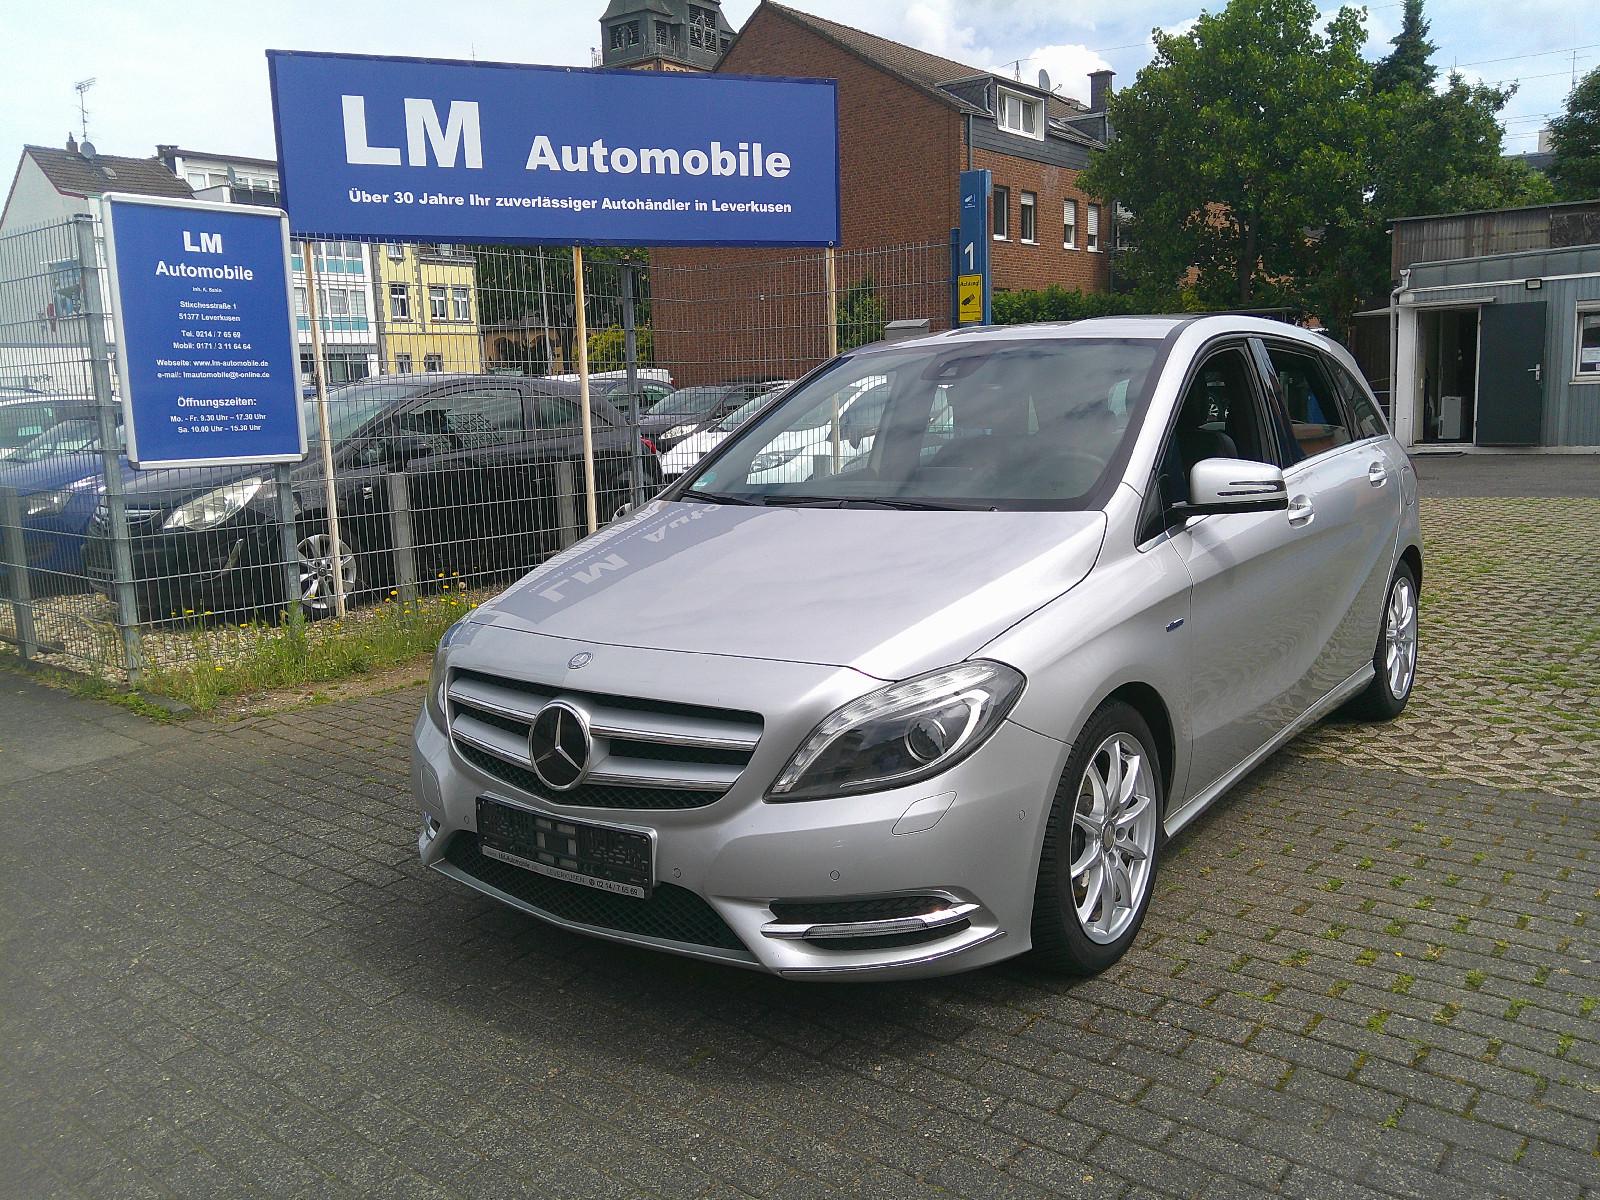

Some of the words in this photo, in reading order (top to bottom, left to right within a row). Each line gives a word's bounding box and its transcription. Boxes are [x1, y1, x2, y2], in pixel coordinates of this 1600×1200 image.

[341, 94, 483, 169] LM
[525, 135, 792, 178] Automobile
[348, 188, 389, 203] Über
[393, 191, 414, 204] 30
[418, 193, 465, 206] Jahre
[469, 193, 491, 206] Ihr
[495, 195, 598, 212] zuverlässiger
[601, 197, 690, 211] Autohändler
[694, 199, 708, 211] in
[711, 199, 792, 213] Leverkusen
[182, 230, 223, 254] LM
[964, 241, 975, 270] 1
[155, 260, 254, 280] Automobile
[178, 312, 200, 320] 51377
[201, 313, 241, 322] Leverkusen
[180, 330, 195, 338] Tel.
[195, 330, 213, 338] 0214
[232, 331, 241, 339] 69
[196, 342, 212, 350] 0171
[156, 359, 192, 367] Webseite:
[177, 395, 257, 409] Öffnungszeiten:
[169, 415, 184, 423] Mo.
[200, 414, 215, 422] 9.30
[235, 413, 253, 421] 17.30
